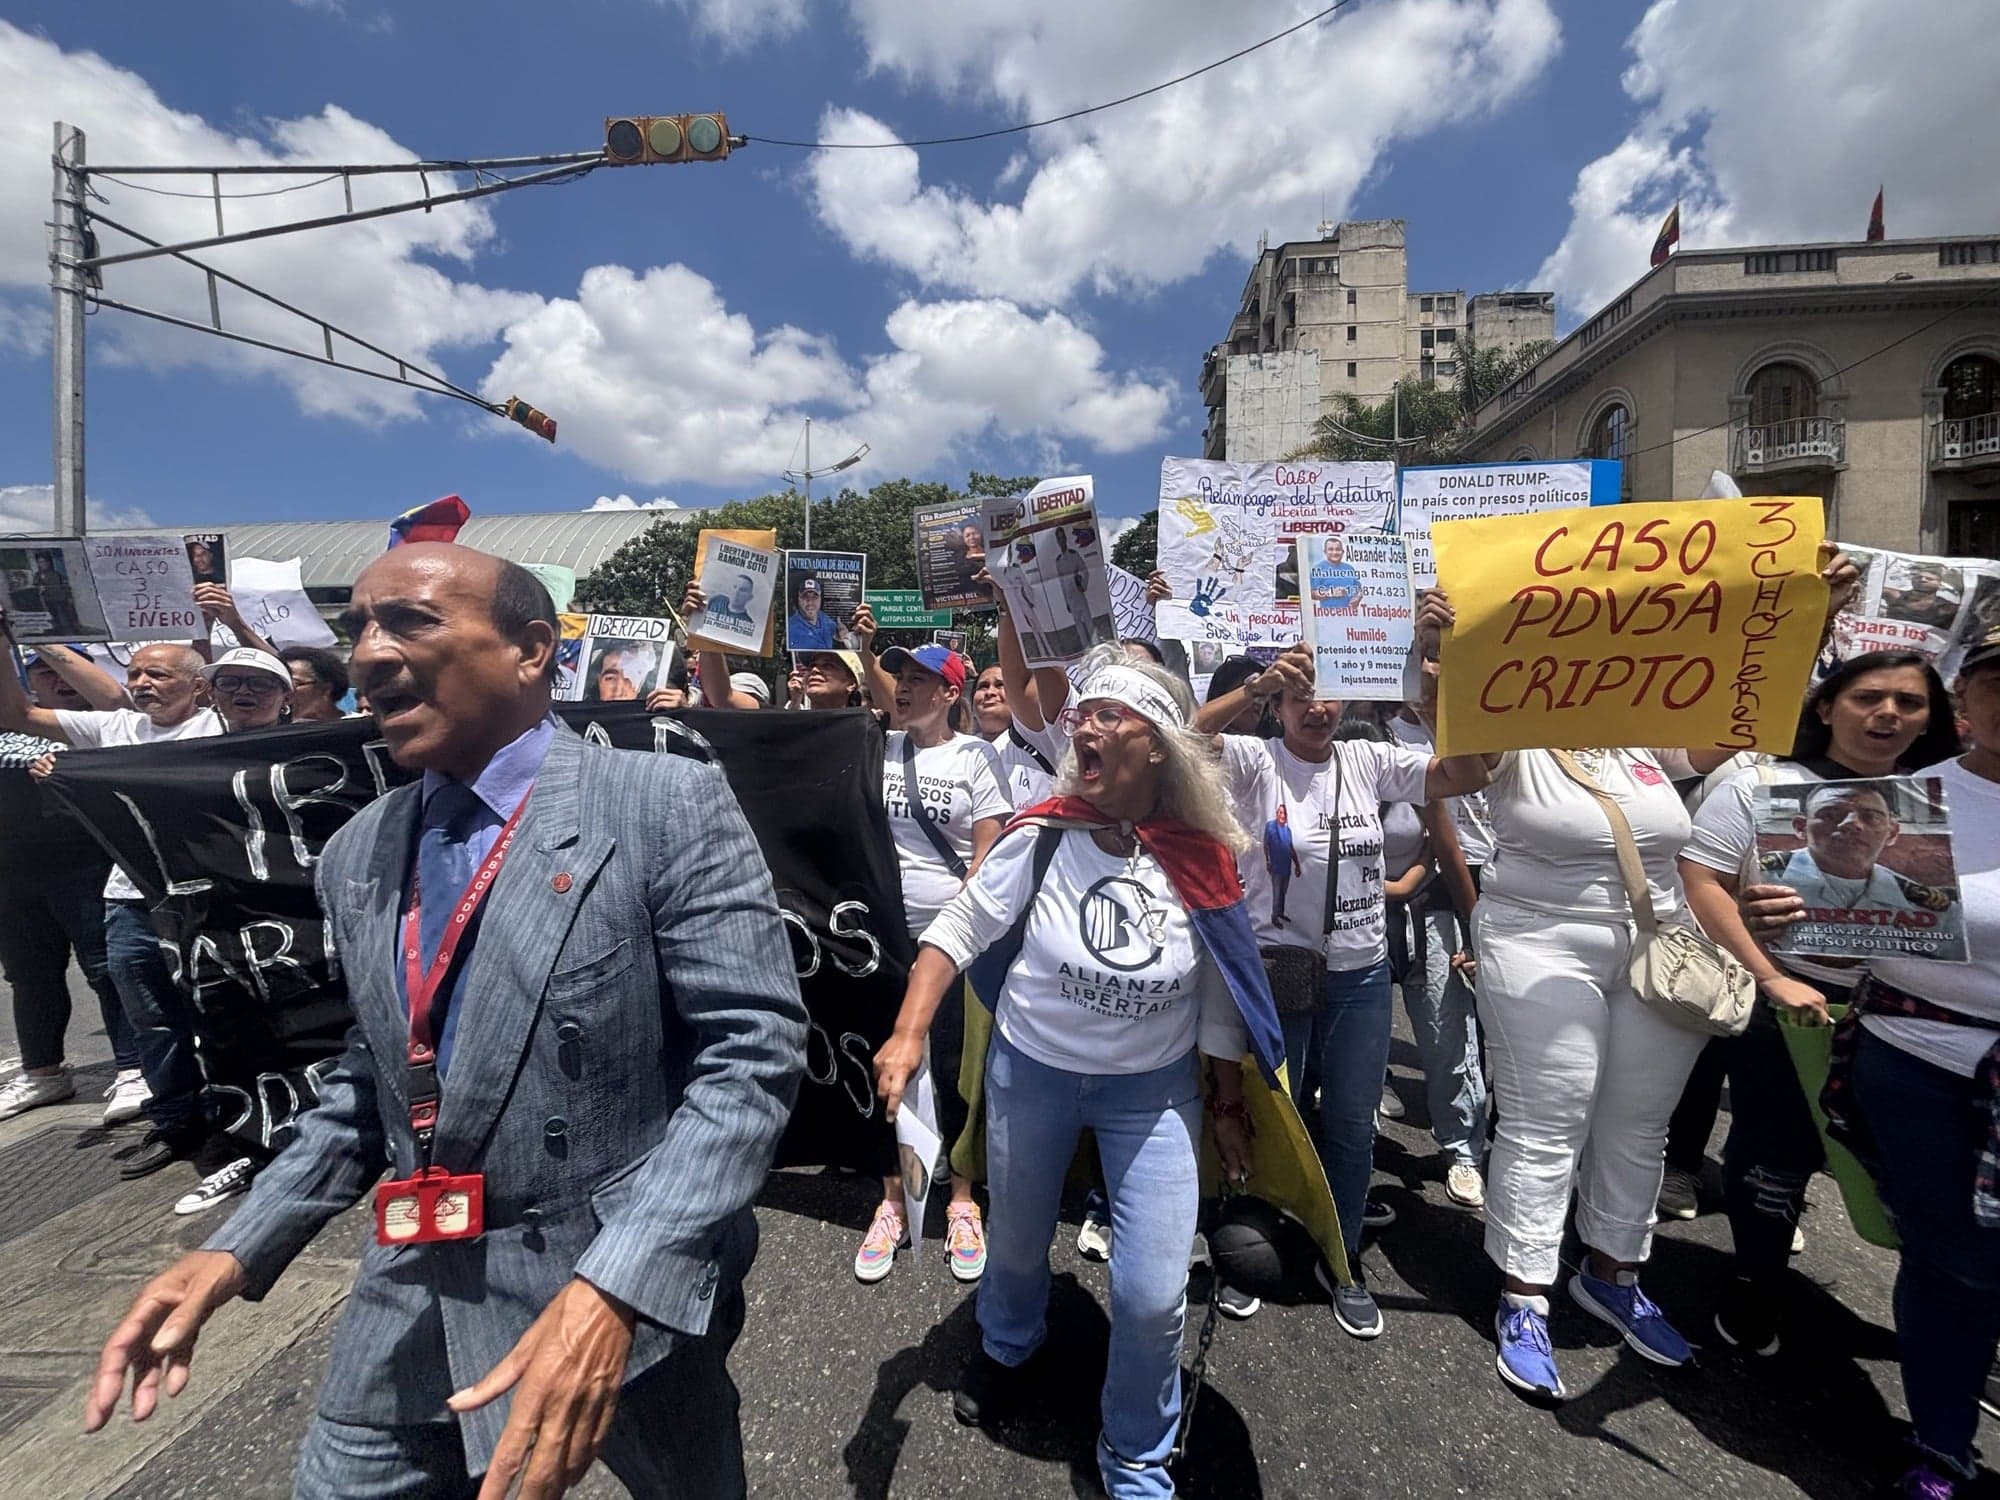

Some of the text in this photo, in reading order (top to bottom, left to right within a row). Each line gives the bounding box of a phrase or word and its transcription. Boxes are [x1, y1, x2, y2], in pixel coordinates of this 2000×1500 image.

[1275, 465, 1322, 486] Caso
[1439, 472, 1550, 489] DONALD TRUMP:
[1031, 488, 1085, 515] LIBERTAD
[1290, 486, 1316, 506] del
[1403, 488, 1588, 509] un país con presos políticos
[1283, 522, 1345, 533] LIBERTAD
[1745, 502, 1796, 547] 3
[719, 544, 769, 564] LIBERTAD PARA
[1345, 546, 1386, 563] Alexander
[1533, 519, 1717, 577] CASO
[115, 560, 169, 575] CASO
[746, 560, 767, 574] SOTO
[1371, 568, 1408, 580] Ramos
[136, 577, 148, 592] 3
[132, 593, 162, 610] DE
[128, 611, 196, 628] ENERO
[1225, 609, 1240, 623] Un
[1313, 604, 1412, 621] Inocente Trabajador
[1502, 580, 1722, 644] PDVSA
[590, 615, 665, 639] LIBERTAD
[1346, 628, 1387, 641] Humilde
[1317, 646, 1357, 655] Detenido
[1360, 646, 1367, 654] el
[1359, 662, 1365, 671] y
[1367, 661, 1373, 670] 9
[1375, 661, 1402, 670] meses
[1341, 675, 1398, 685] Injustamente
[1479, 655, 1715, 713] CRIPTO
[918, 776, 955, 789] TODOS
[1868, 926, 1954, 940] Zambrano
[1792, 934, 1938, 952] PRESO POLITICO
[1058, 962, 1181, 993] ALIANZA
[1061, 982, 1172, 1015] LIBERTAD
